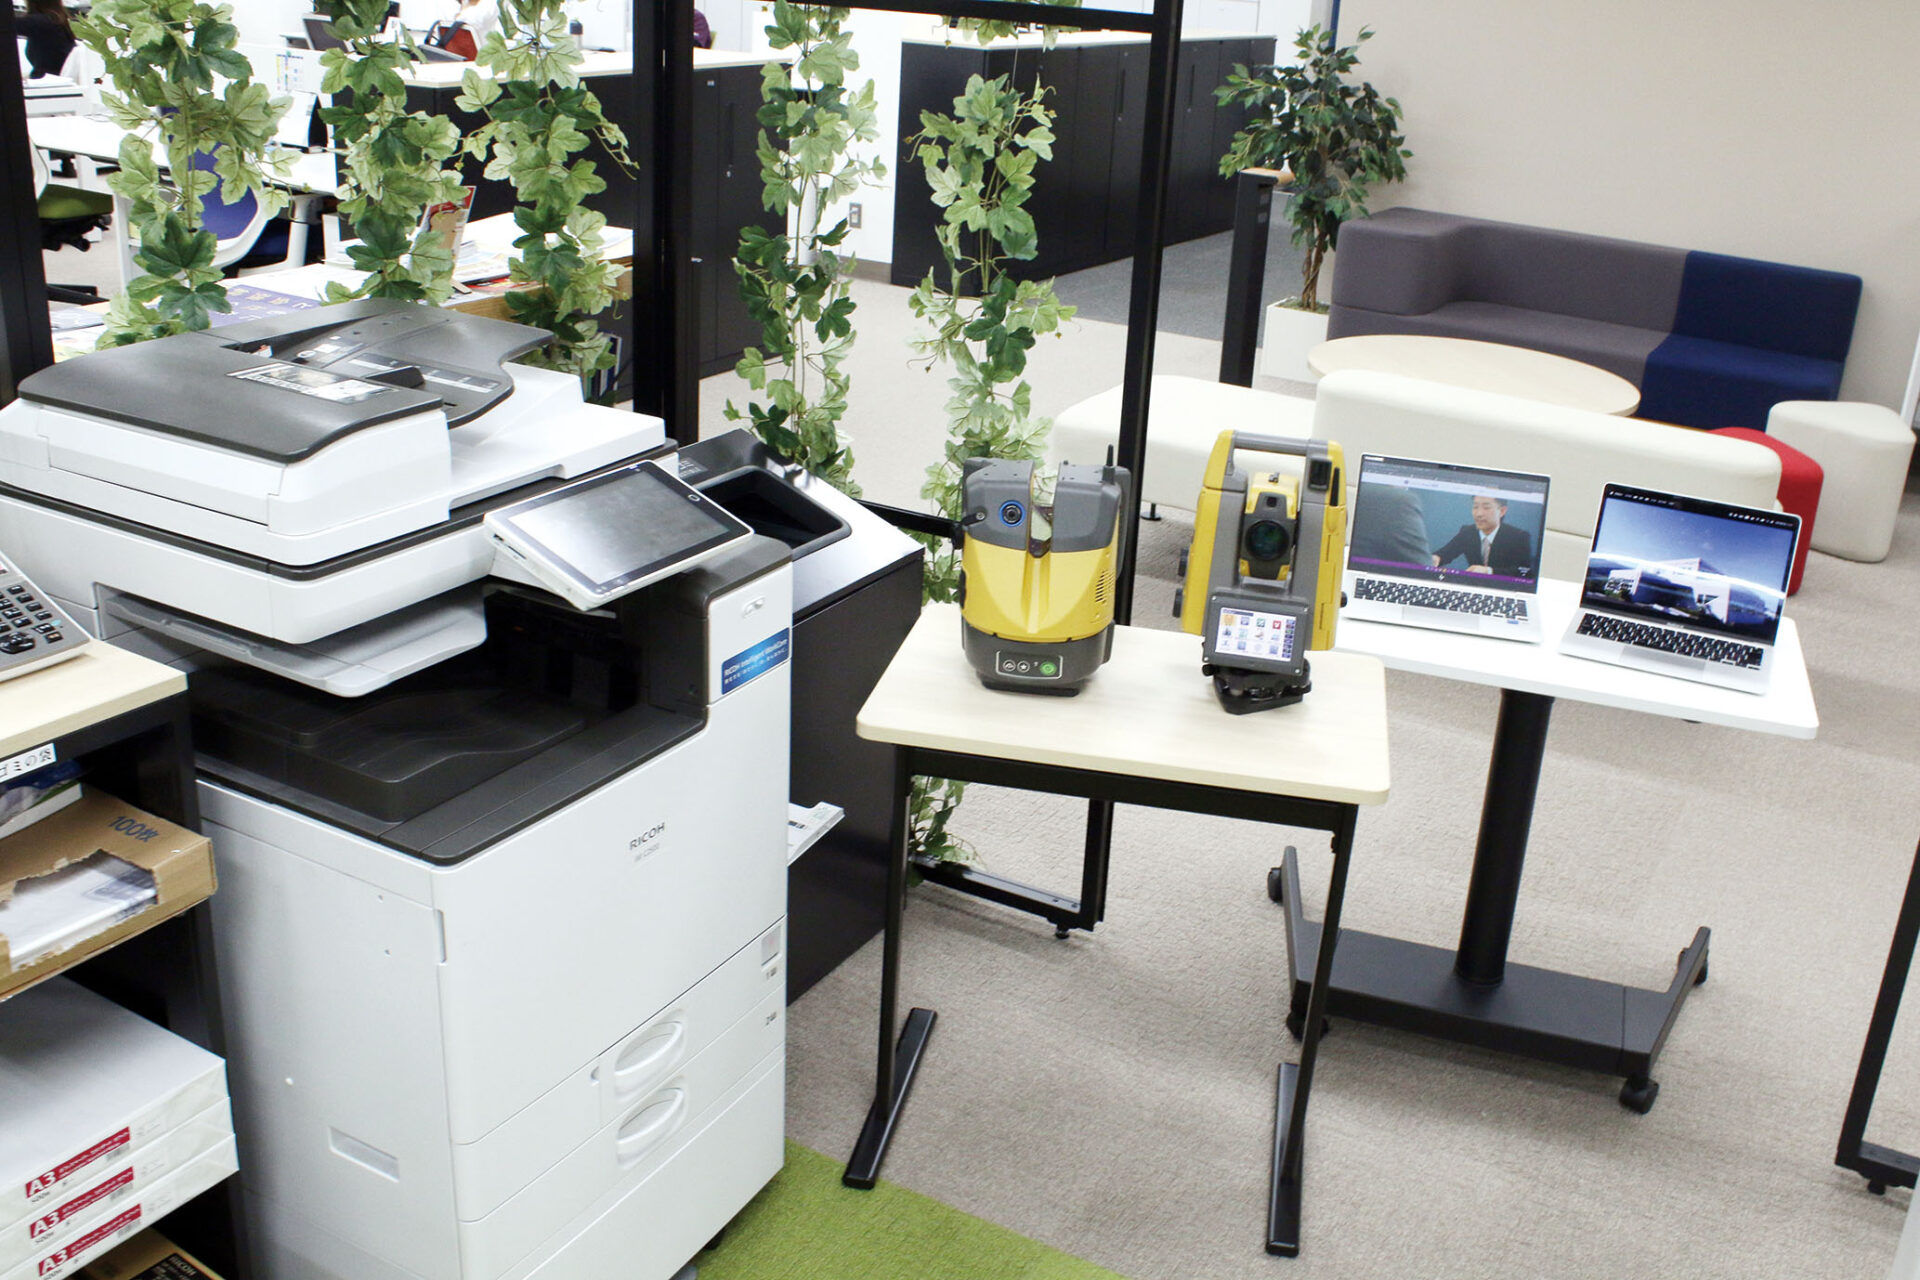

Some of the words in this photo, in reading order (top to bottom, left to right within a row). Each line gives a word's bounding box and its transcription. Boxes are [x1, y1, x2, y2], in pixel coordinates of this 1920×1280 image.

[108, 815, 160, 843] 100枚
[629, 822, 666, 850] RICOH
[28, 1171, 57, 1196] A3
[33, 1210, 61, 1236] A3
[42, 1248, 69, 1274] A3
